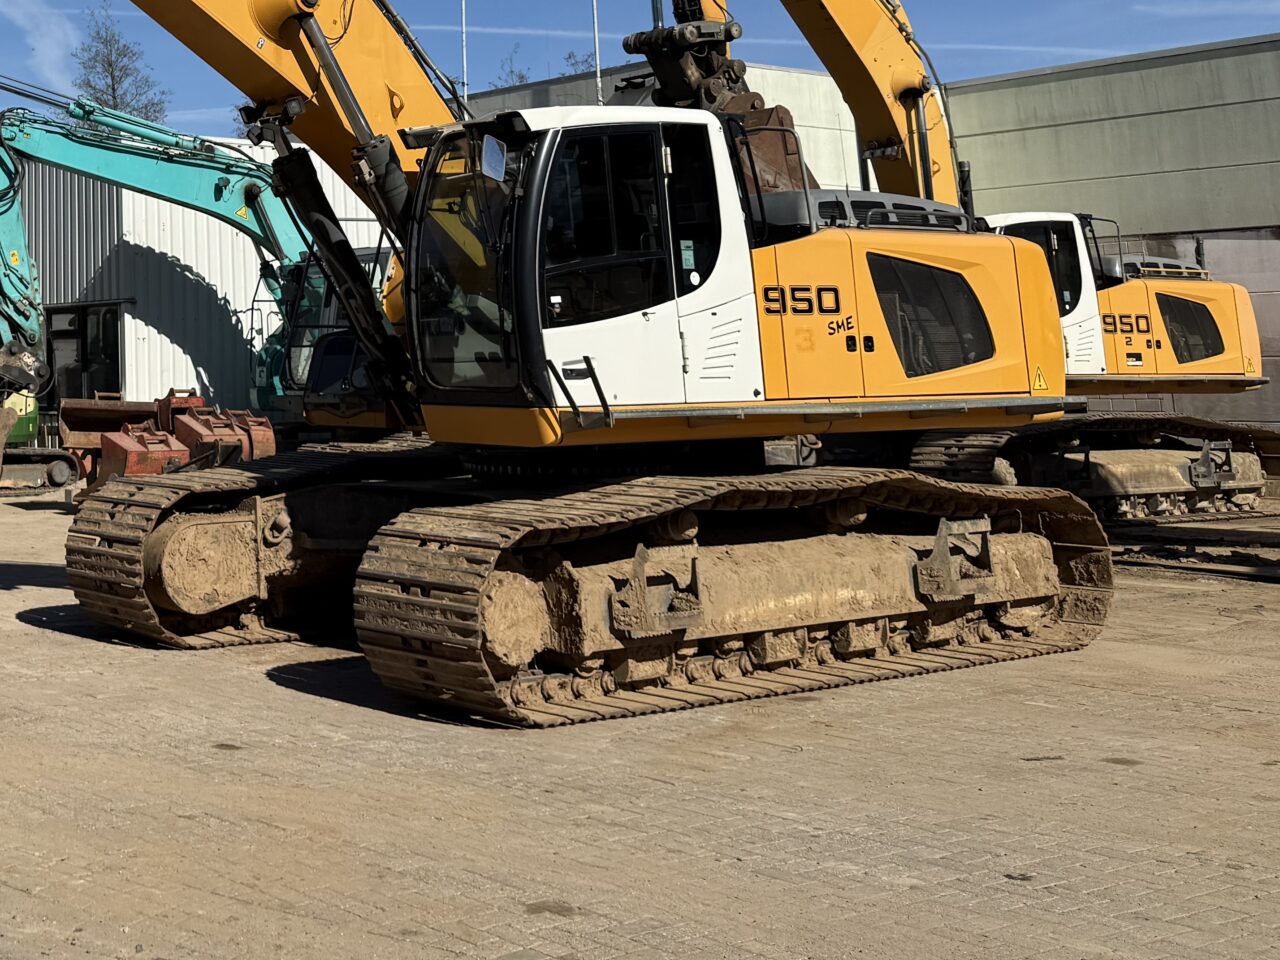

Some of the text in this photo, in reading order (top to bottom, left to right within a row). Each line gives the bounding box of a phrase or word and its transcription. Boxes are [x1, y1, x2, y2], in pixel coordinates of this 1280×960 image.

[762, 285, 841, 315] 950
[827, 315, 855, 336] SME
[1102, 313, 1151, 334] 950
[1124, 336, 1133, 346] 2
